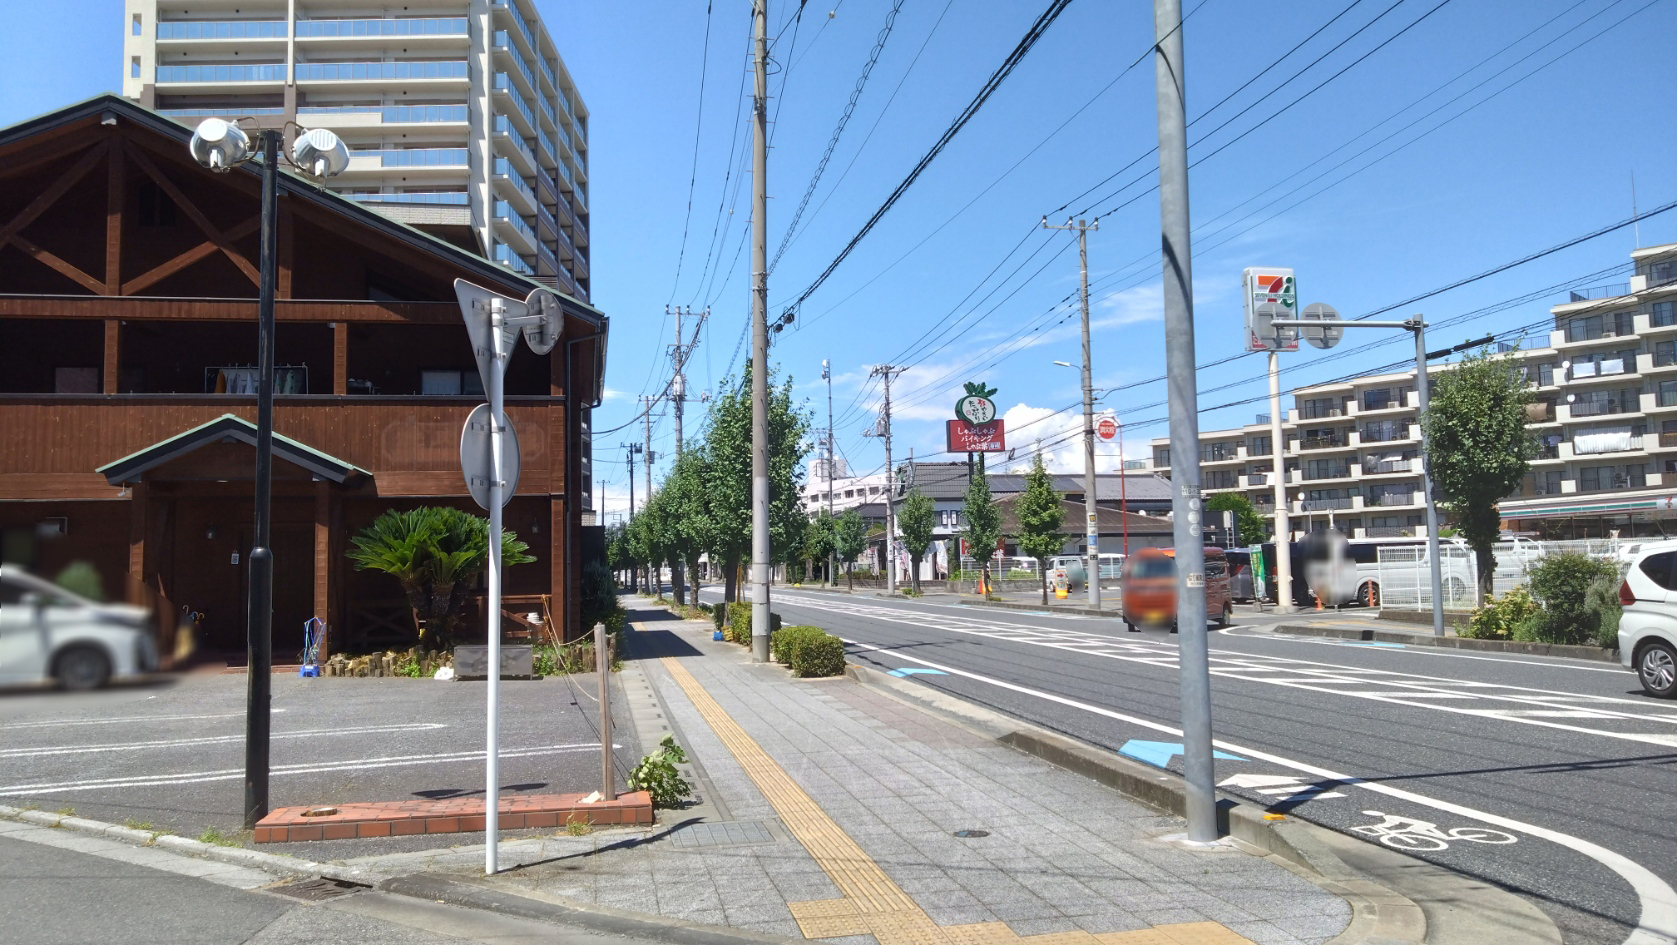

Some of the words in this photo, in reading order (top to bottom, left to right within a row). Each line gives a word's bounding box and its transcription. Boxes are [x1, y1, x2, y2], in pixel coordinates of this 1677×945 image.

[957, 427, 996, 435] しゃぶしゃぶ
[960, 435, 994, 443] バイキング
